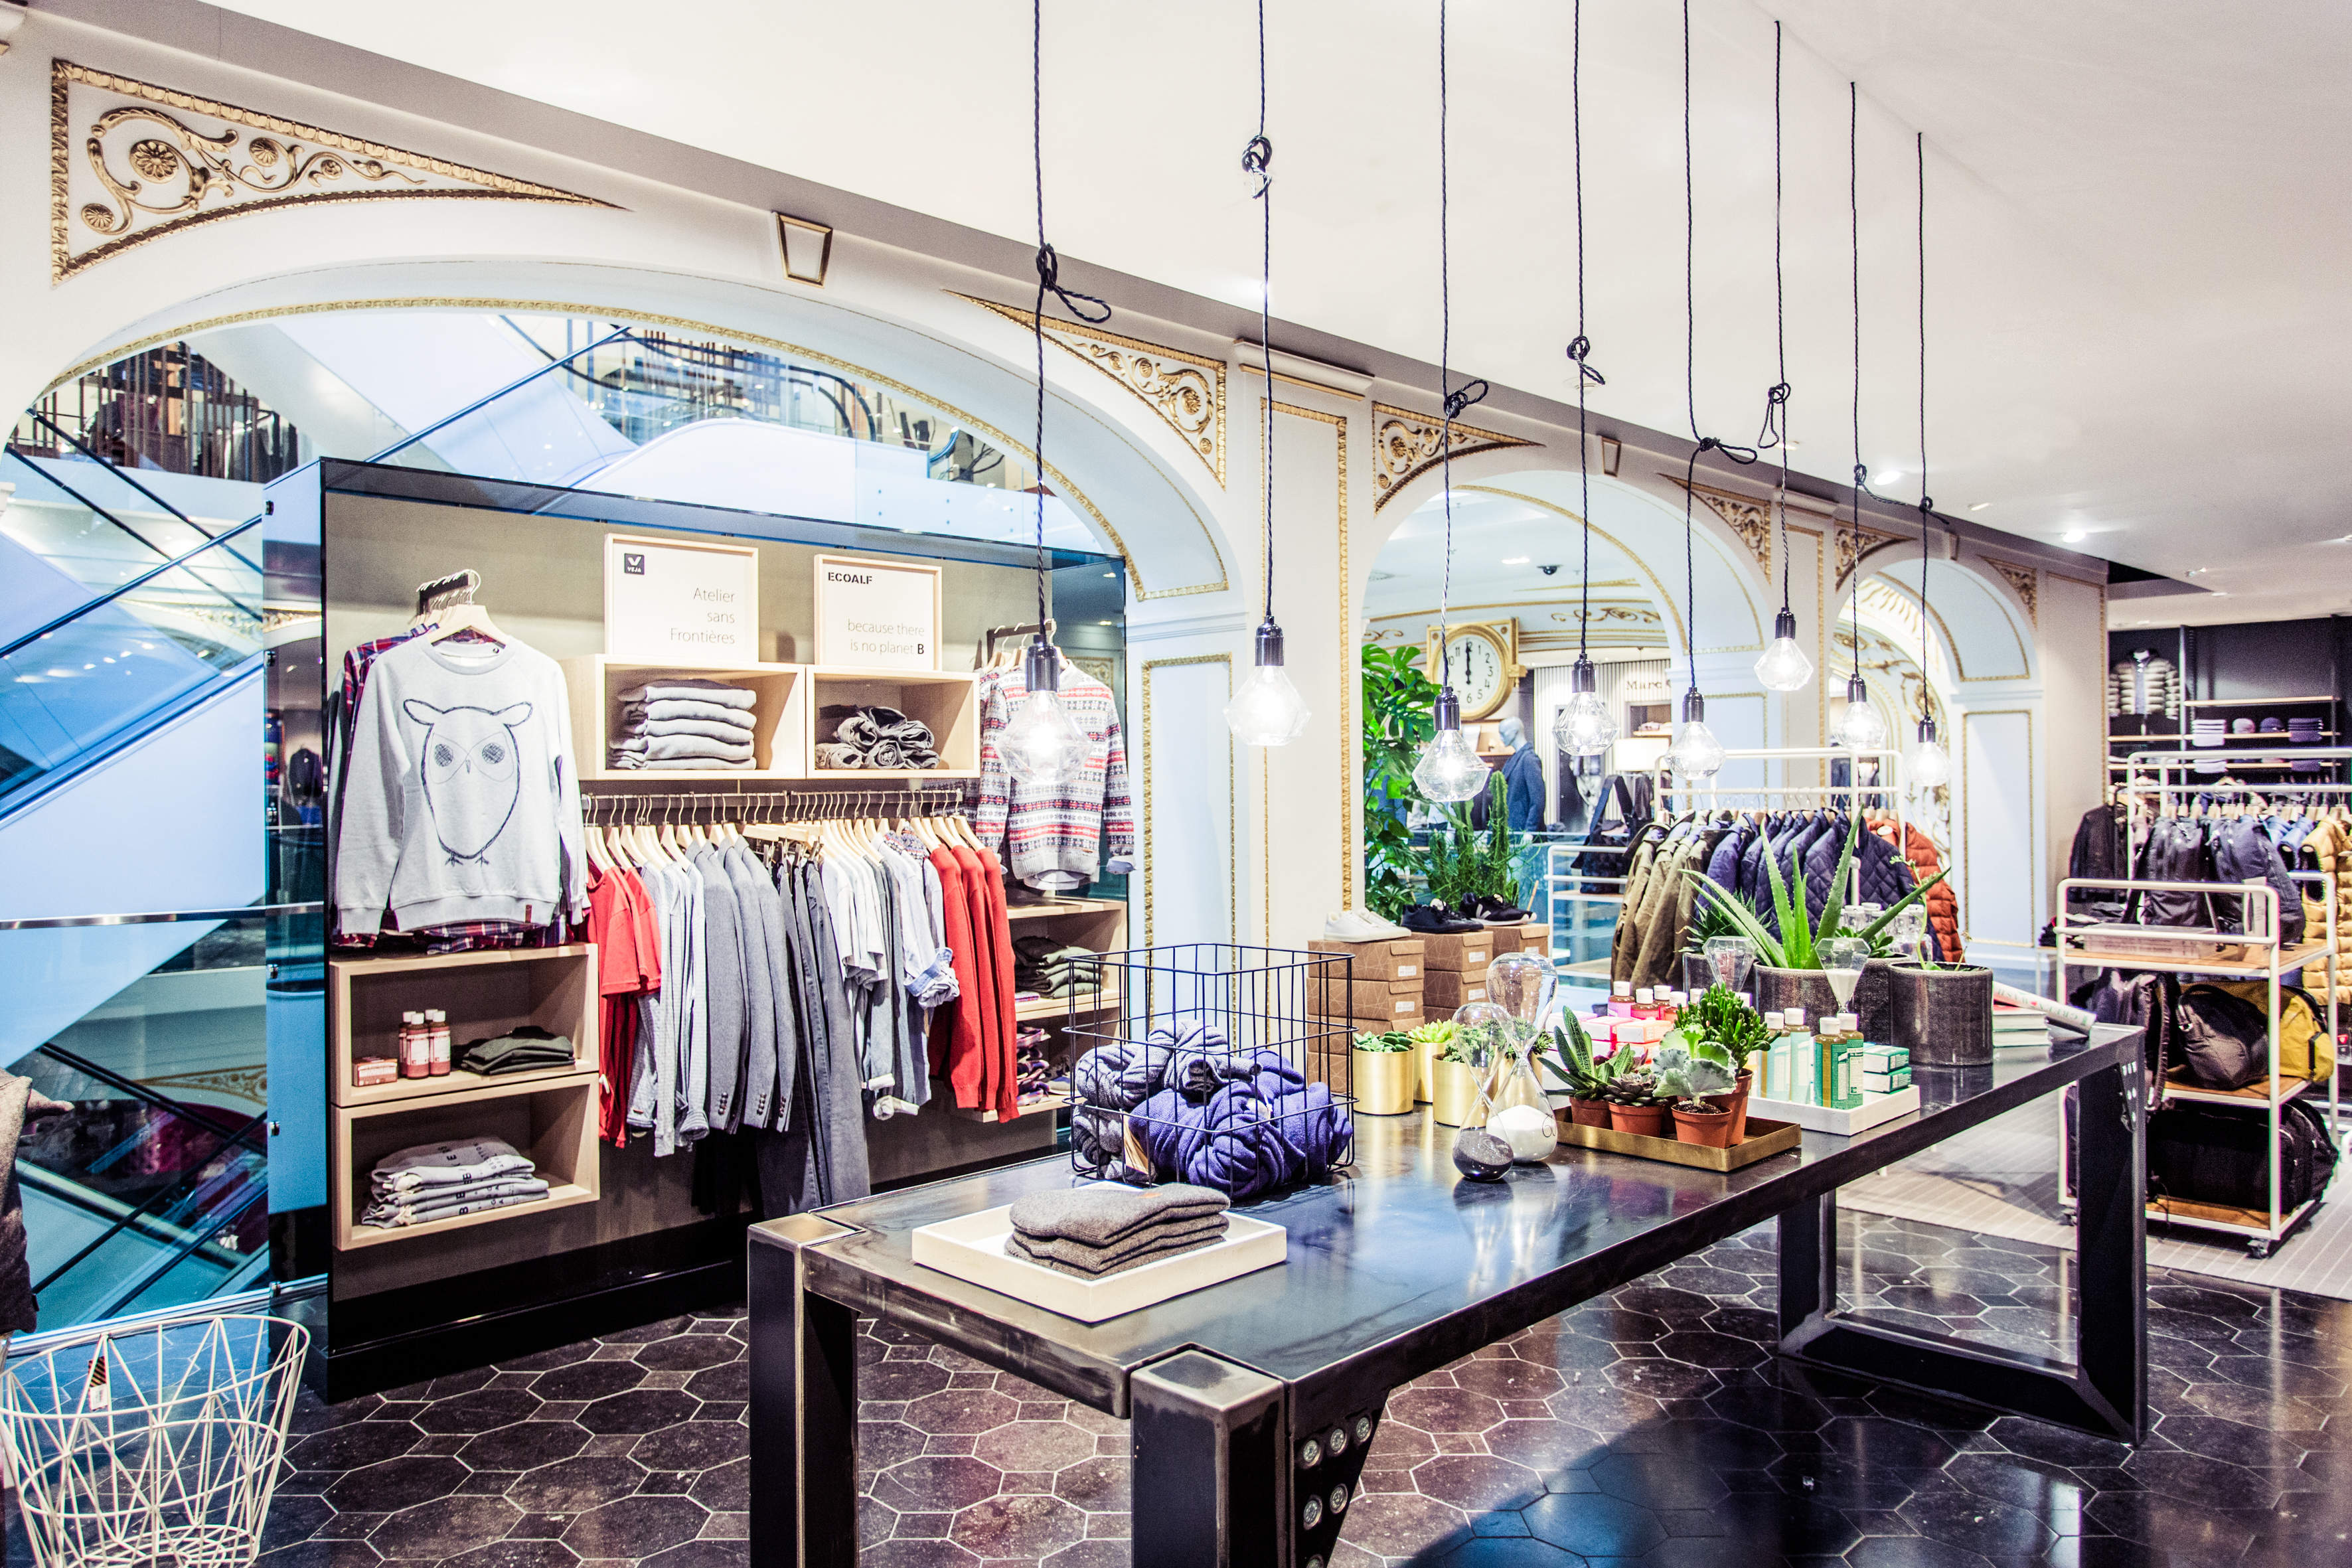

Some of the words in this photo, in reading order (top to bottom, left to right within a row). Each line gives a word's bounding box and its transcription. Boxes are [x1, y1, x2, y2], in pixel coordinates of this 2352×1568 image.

[828, 572, 872, 584] ECOALF
[693, 588, 735, 603] Atelier
[707, 611, 735, 623] sans
[848, 618, 894, 634] because
[897, 623, 925, 637] there
[670, 628, 735, 644] Frontières
[850, 639, 858, 651] is
[862, 642, 876, 652] no
[880, 641, 914, 655] planet
[917, 643, 924, 655] B
[1455, 647, 1460, 657] 11
[1485, 653, 1490, 663] 2
[1487, 666, 1493, 677] 3
[1484, 678, 1490, 689] 4
[1466, 693, 1472, 704] 6
[1477, 689, 1483, 700] 5
